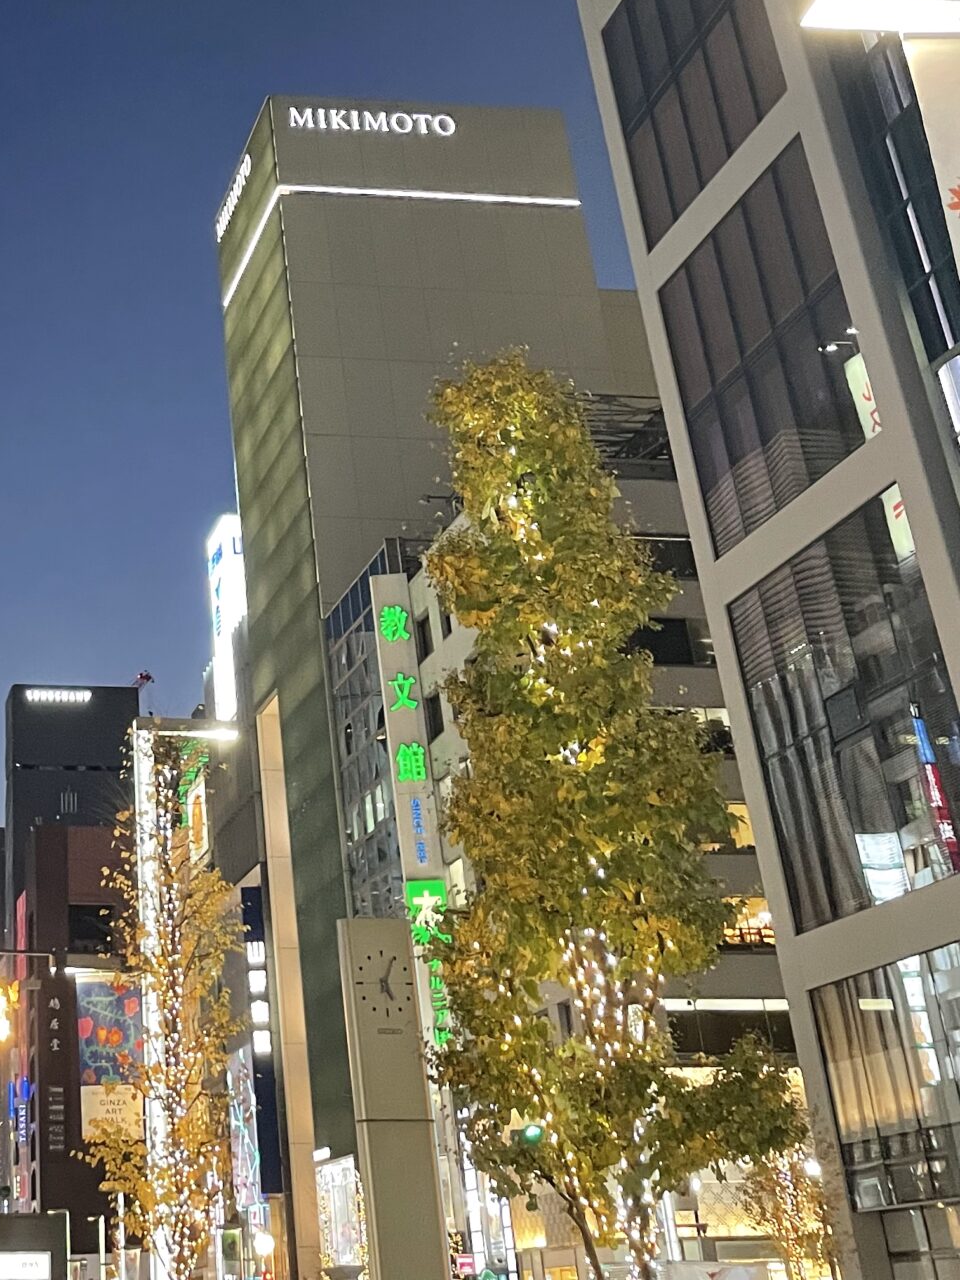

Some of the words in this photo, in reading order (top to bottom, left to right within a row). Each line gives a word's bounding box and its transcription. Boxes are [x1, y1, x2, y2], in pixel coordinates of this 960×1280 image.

[288, 105, 456, 137] MIKIMOTO
[379, 604, 427, 783] 教文館
[99, 1099, 128, 1107] GINZA
[18, 1103, 27, 1143] TASAKI
